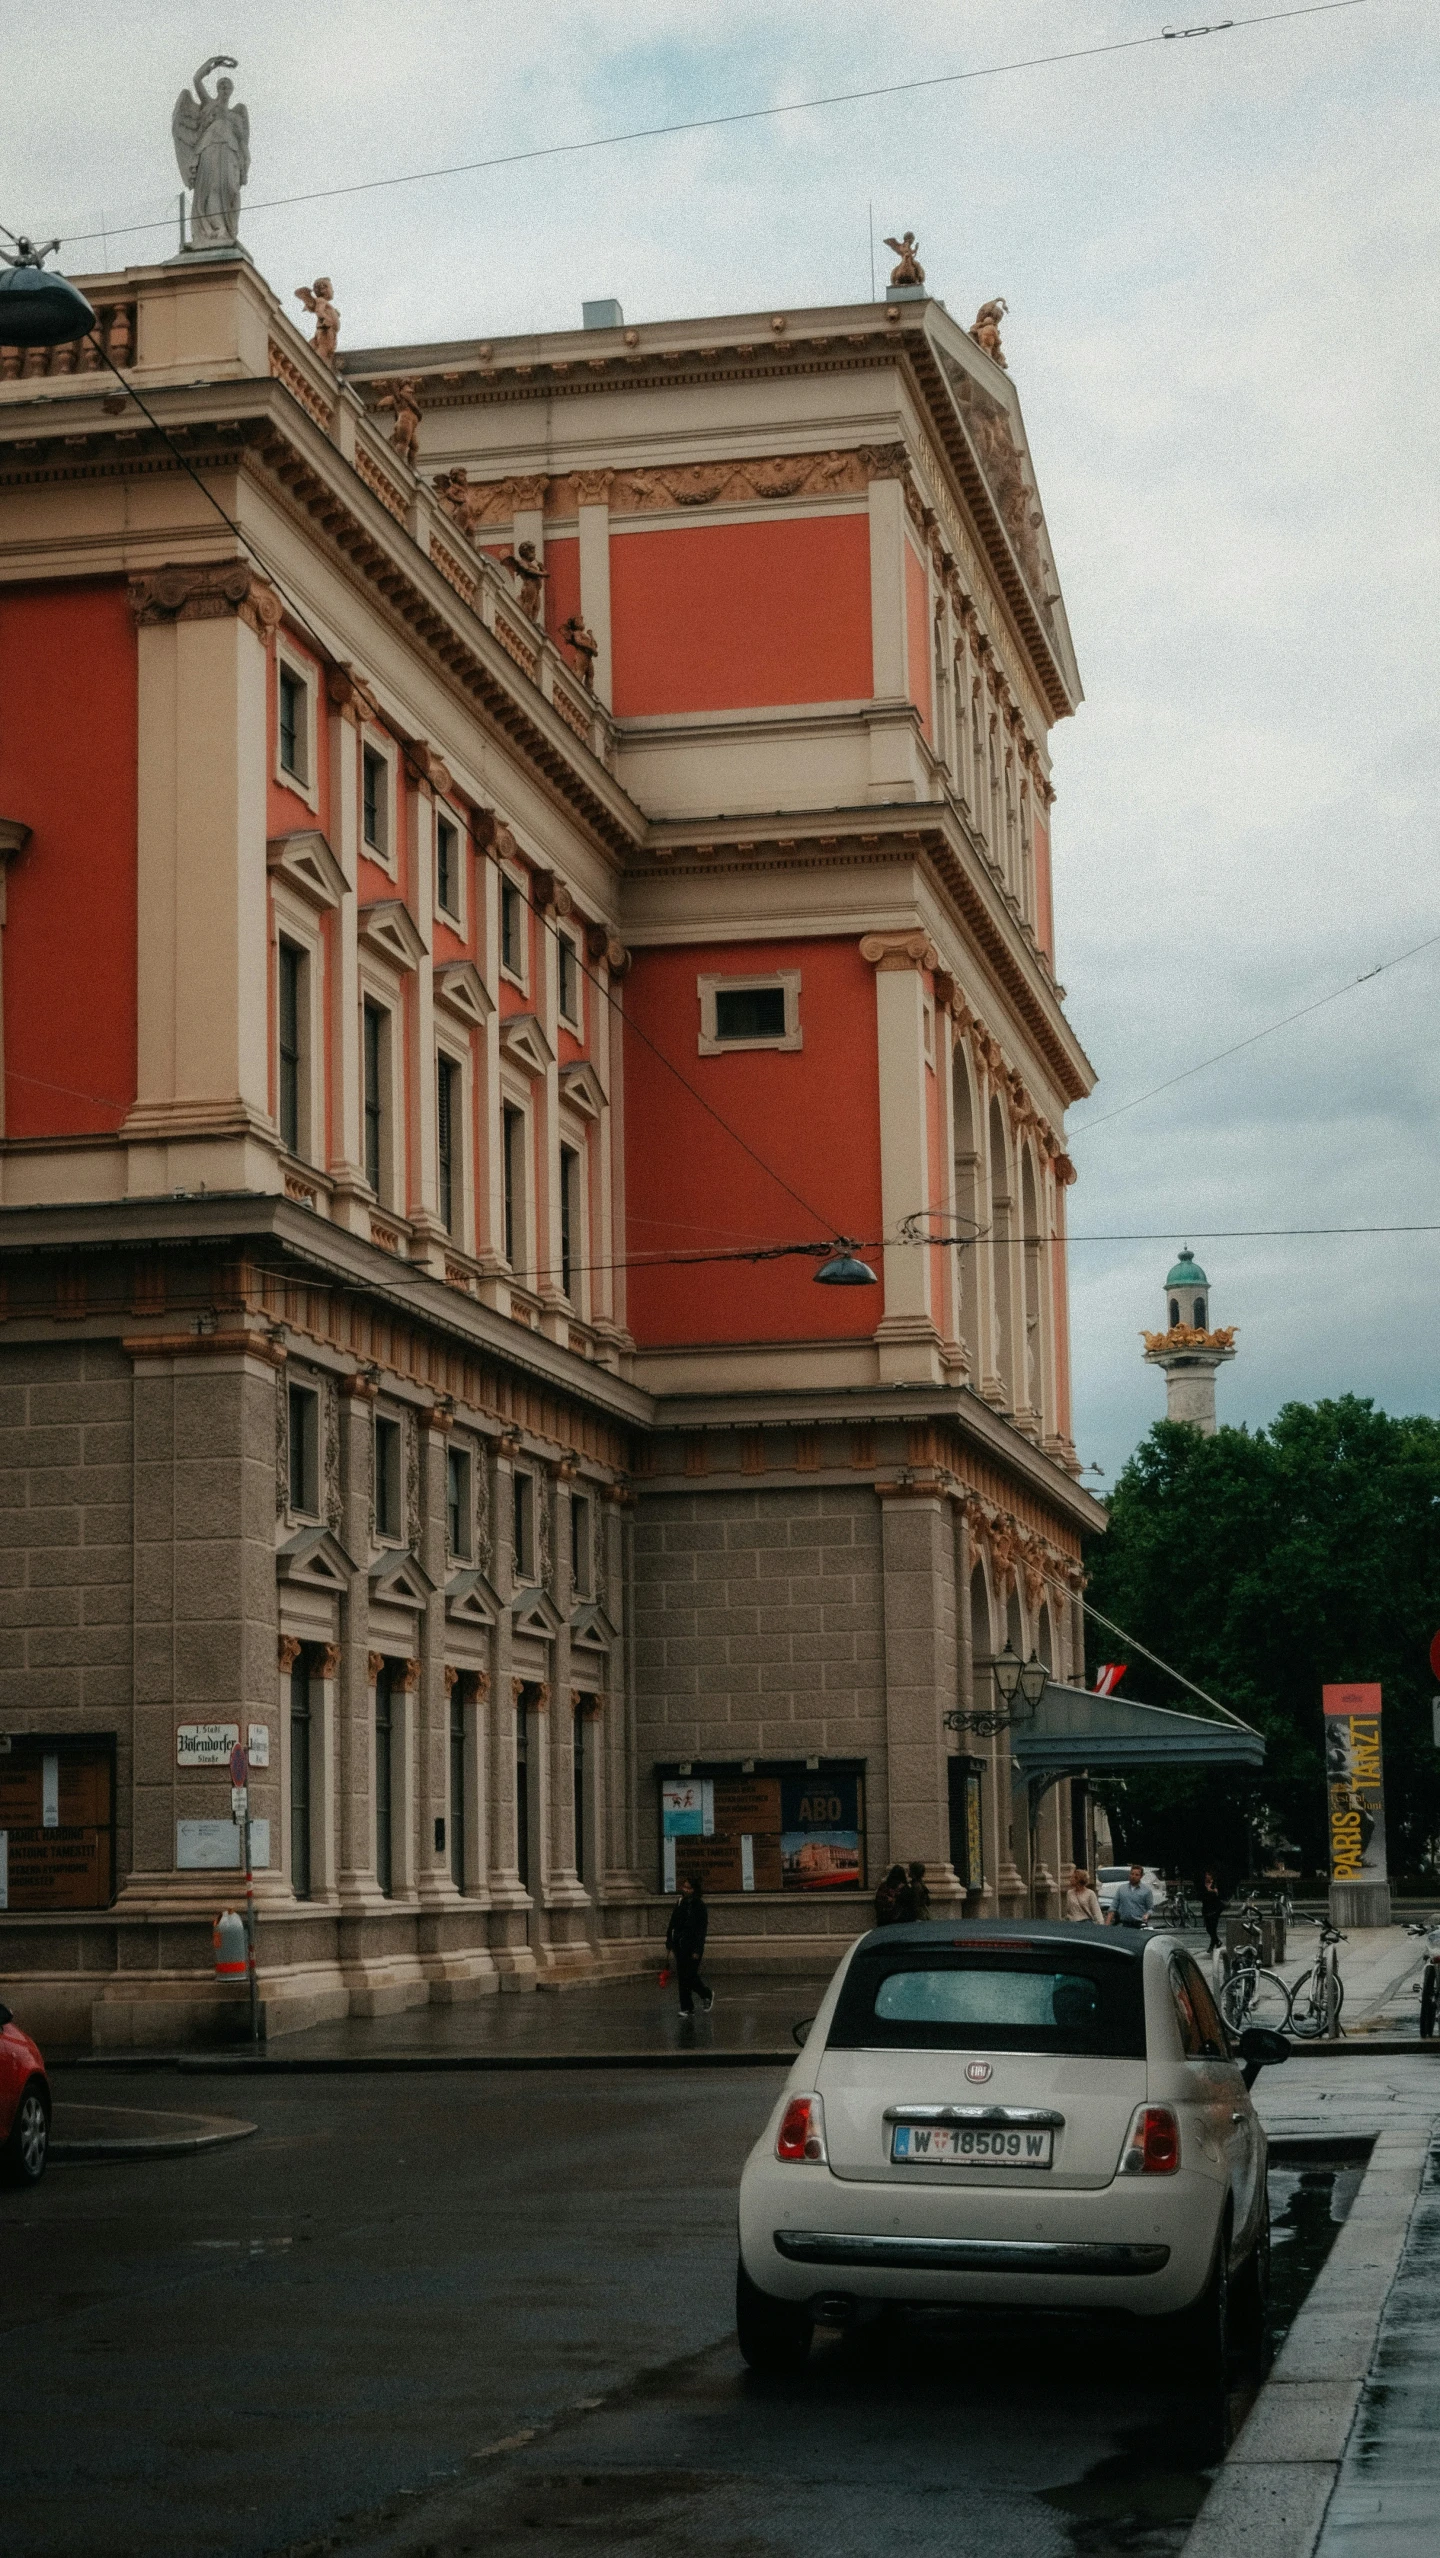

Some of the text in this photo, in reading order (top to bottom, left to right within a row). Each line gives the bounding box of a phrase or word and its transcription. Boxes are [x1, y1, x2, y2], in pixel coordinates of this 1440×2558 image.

[178, 1734, 237, 1753] Bösendorfer
[1349, 1715, 1380, 1792] TANZT
[799, 1797, 842, 1821] ABO
[1332, 1811, 1362, 1880] PARIS
[971, 2066, 987, 2076] FIAT
[914, 2131, 1043, 2157] W 18509 W
